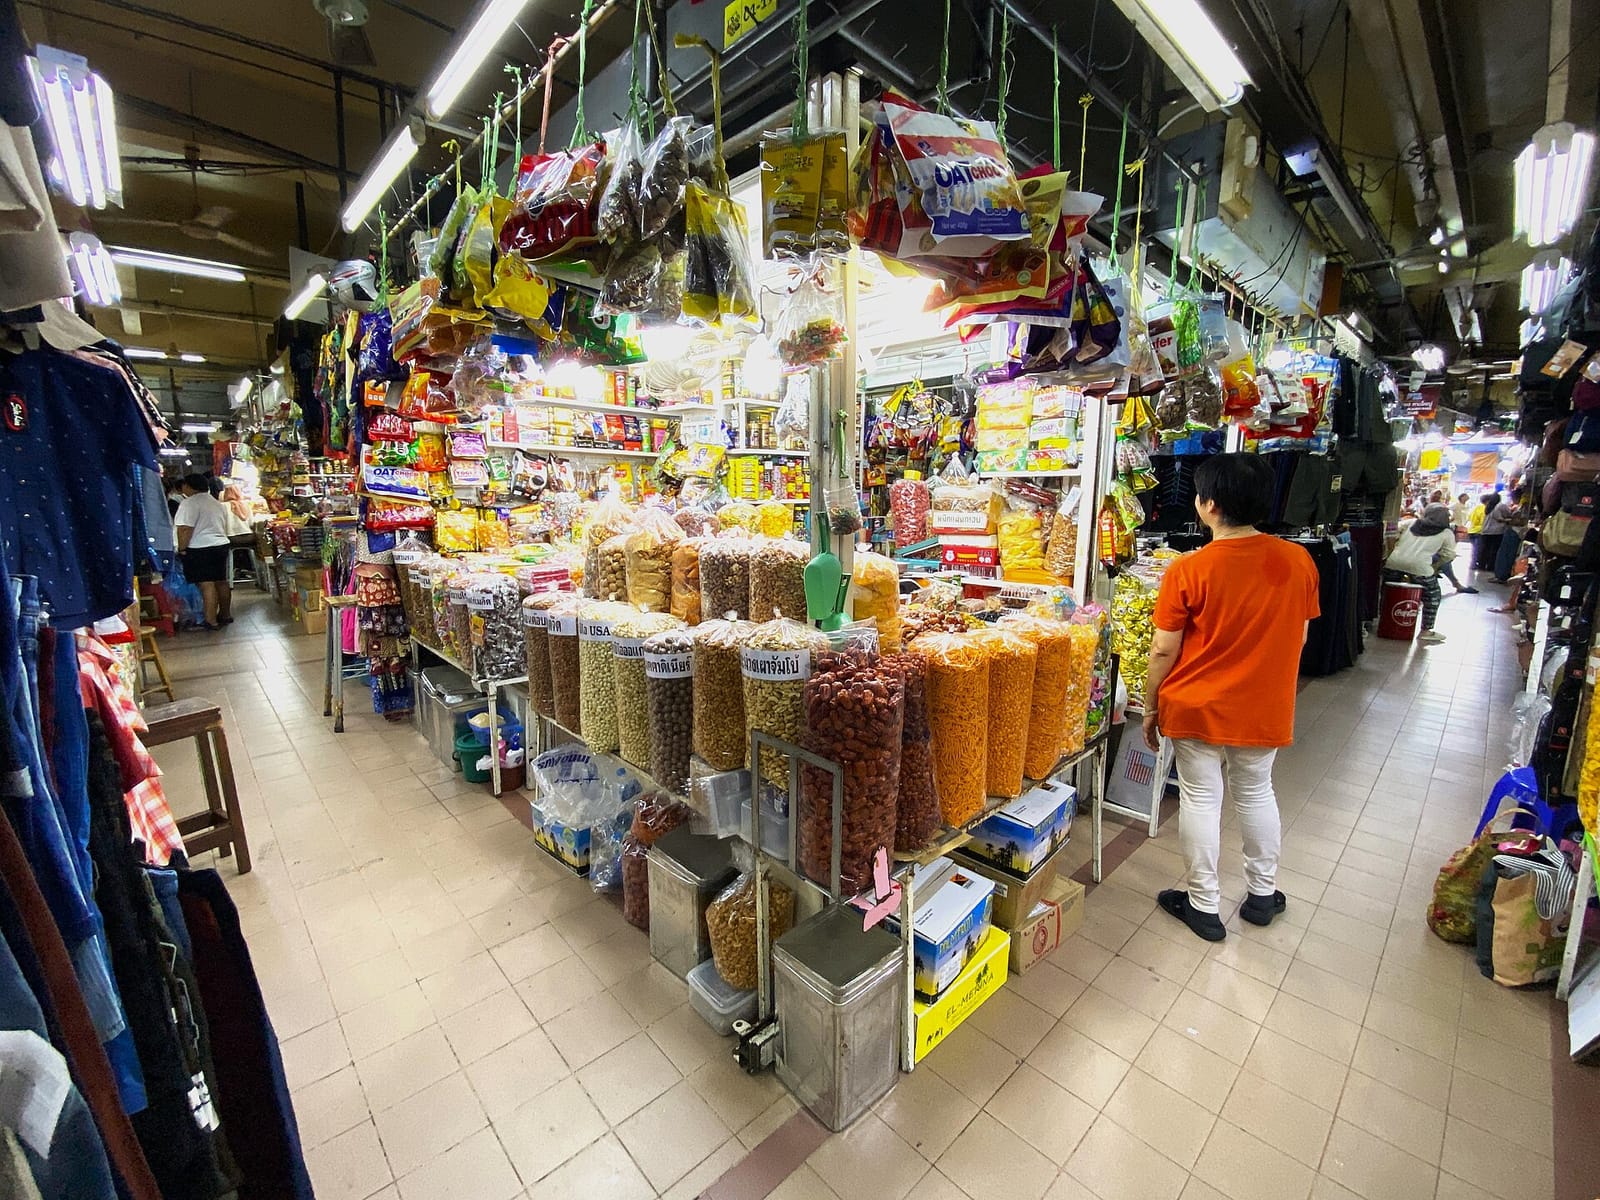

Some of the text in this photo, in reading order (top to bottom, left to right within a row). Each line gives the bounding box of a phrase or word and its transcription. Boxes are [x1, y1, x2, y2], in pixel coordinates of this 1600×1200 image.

[935, 161, 972, 188] OAT
[373, 467, 396, 476] OAT
[589, 626, 611, 637] USA
